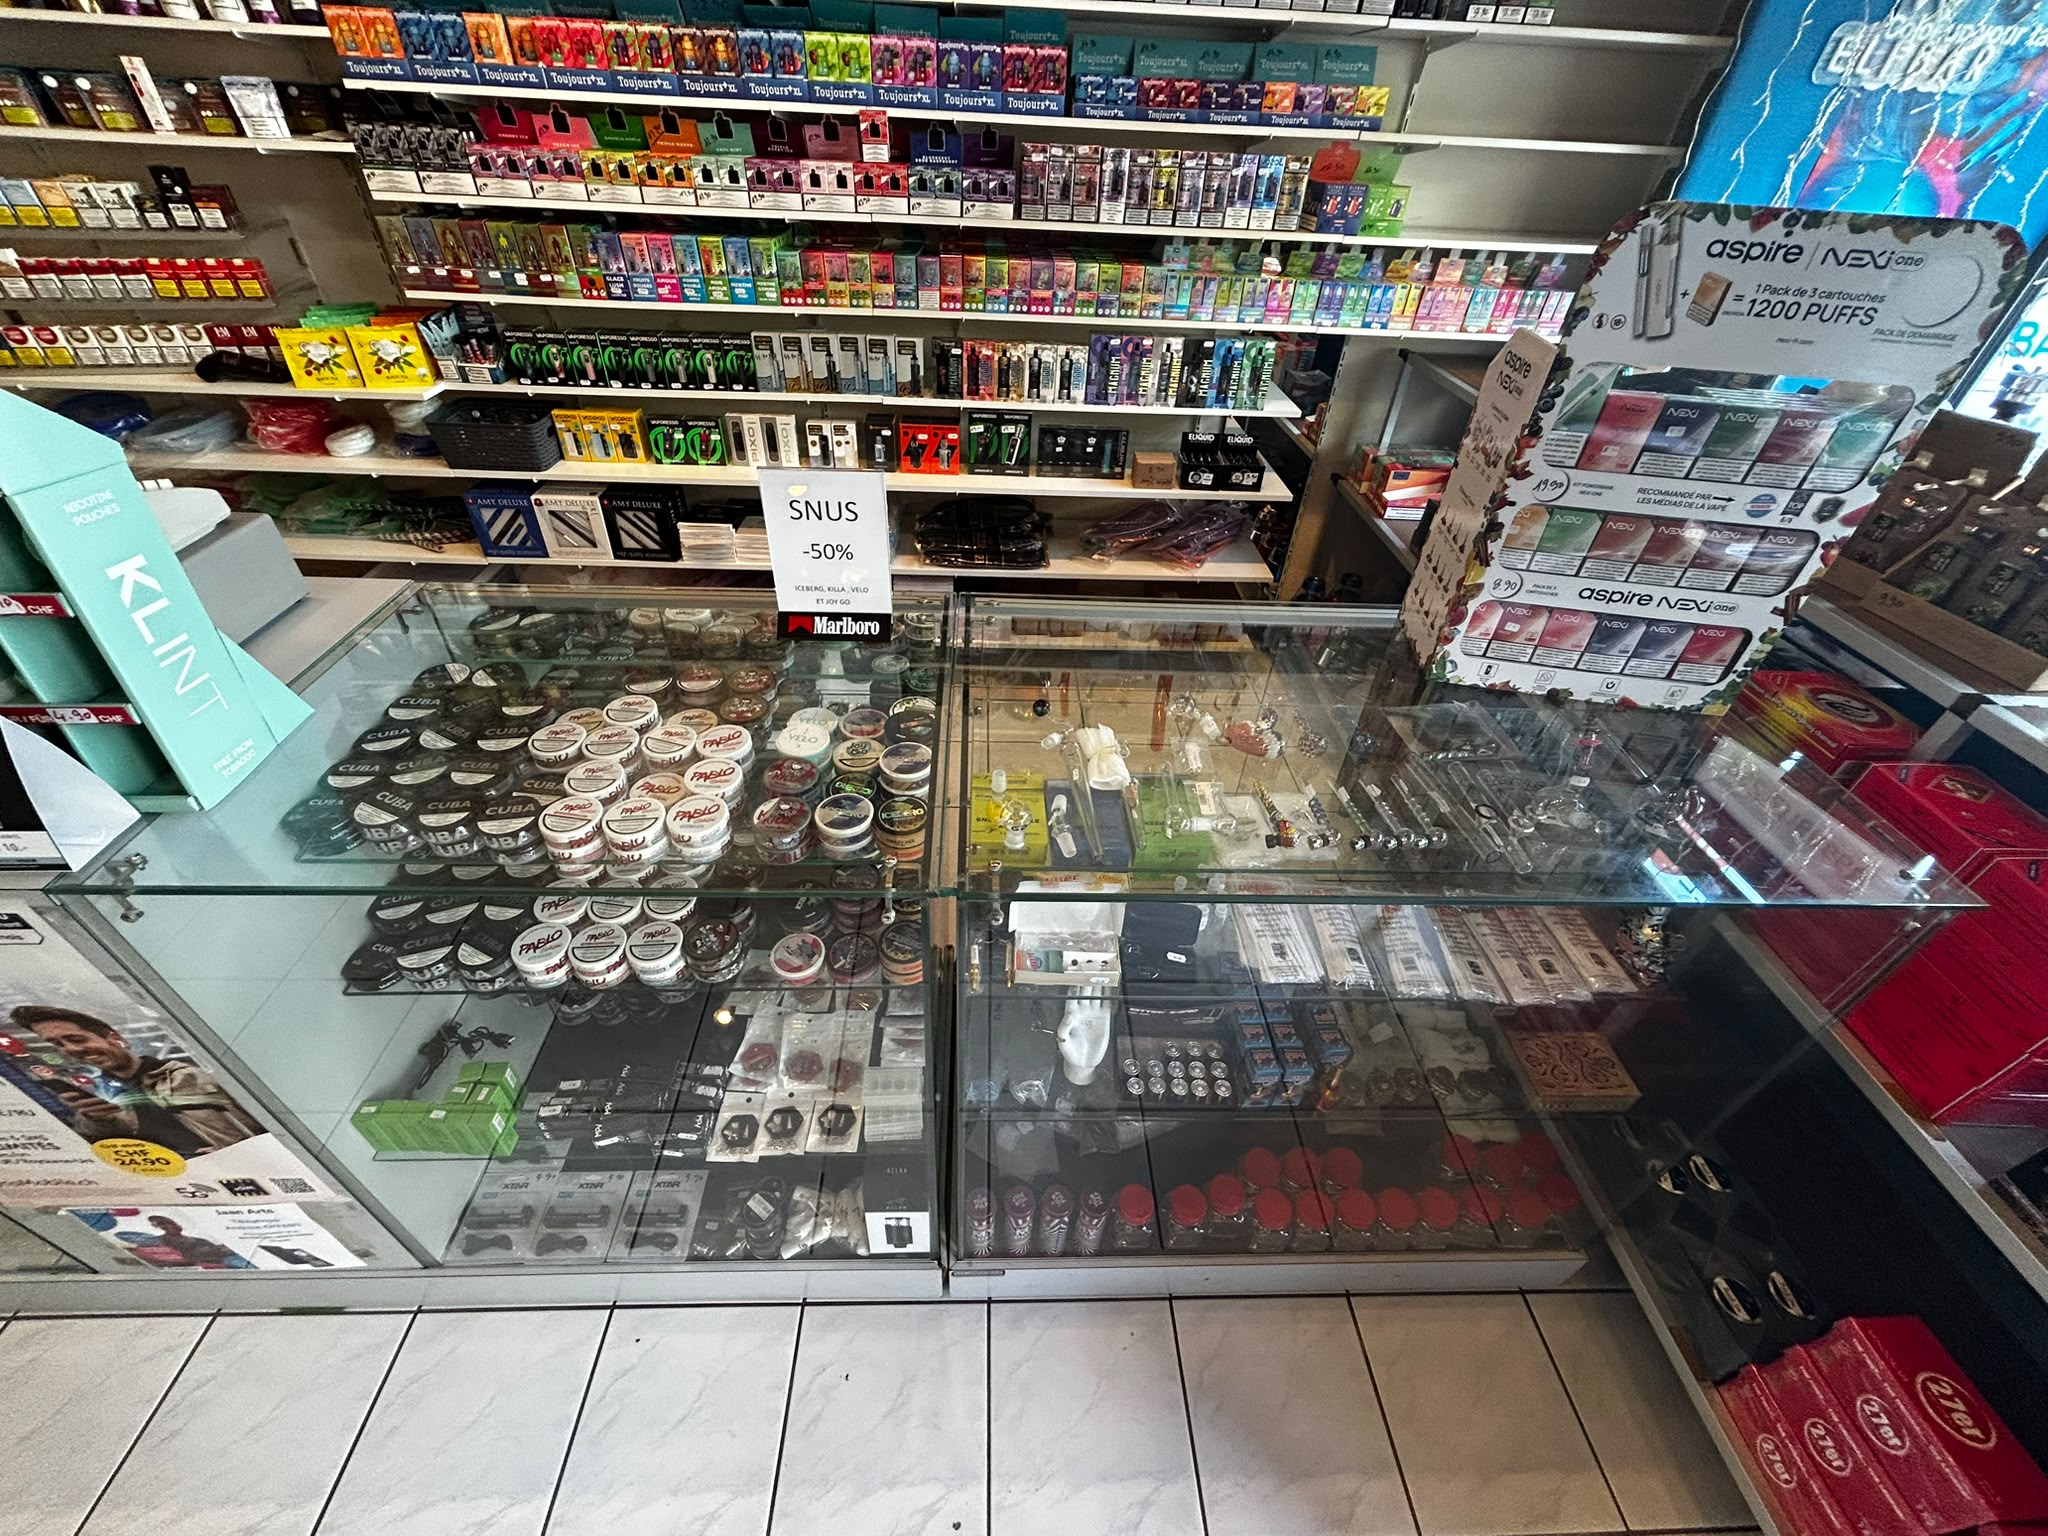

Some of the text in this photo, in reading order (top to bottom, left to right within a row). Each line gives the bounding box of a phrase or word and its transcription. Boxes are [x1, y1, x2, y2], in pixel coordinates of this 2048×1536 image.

[1706, 230, 1803, 264] aspire
[1895, 255, 1925, 269] one
[1755, 284, 1887, 303] 1 Pack de 3 cartouches
[1746, 299, 1878, 326] 1200 PUFFS
[503, 331, 533, 339] VAPORESSO
[536, 332, 565, 340] VAPORESSO
[1505, 350, 1532, 379] aspire
[1107, 356, 1121, 394] MAGNUM
[1138, 356, 1152, 394] MAGNUM
[1168, 358, 1182, 396] MAGNUM
[1199, 359, 1213, 397] MAGNUM
[1229, 360, 1242, 397] MAGNUM
[1260, 361, 1273, 399] MAGNUM
[1637, 487, 1713, 501] RECOMMANDÉ PAR
[62, 489, 115, 515] NICOTINE
[477, 498, 529, 507] AMY DELUXE
[545, 499, 596, 508] AMY DELUXE
[613, 500, 663, 509] AMY DELUXE
[1636, 497, 1650, 505] LES
[1651, 497, 1682, 507] MÉDIAS
[1707, 504, 1728, 512] VAPE
[73, 503, 120, 526] POUCHES
[789, 500, 858, 522] SNUS
[803, 543, 854, 560] -50%
[795, 585, 826, 593] ICEBERG,
[1491, 578, 1517, 591] 8.90
[1578, 587, 1653, 607] aspire
[1713, 604, 1736, 612] one
[27, 605, 55, 615] CHF
[813, 616, 880, 635] Marlboro
[105, 553, 229, 719] KLINT
[400, 697, 441, 706] CUBA
[620, 699, 648, 707] PABLO
[52, 710, 91, 722] 4.90
[98, 715, 124, 723] CHF
[568, 710, 595, 721] PABLO
[681, 711, 708, 721] PABLO
[367, 727, 411, 740] CUBA
[485, 726, 530, 736] CUBA
[546, 727, 576, 736] PABLO
[599, 730, 627, 740] PABLO
[789, 733, 818, 743] VELO
[703, 731, 742, 748] PABLO
[212, 738, 254, 772] FREE FROM
[338, 764, 380, 773] CUBA
[395, 756, 447, 770] CUBA
[460, 761, 499, 770] CUBA
[583, 765, 613, 775] PABLO
[690, 767, 735, 782] PABLO
[637, 781, 680, 795] PABLO
[376, 791, 413, 811] CUBA
[427, 800, 471, 810] CUBA
[560, 802, 593, 812] PABLO
[485, 803, 536, 816] CUBA
[620, 803, 651, 815] PABLO
[673, 804, 721, 822] PABLO
[586, 929, 615, 942] PABLO
[642, 926, 672, 941] PABLO
[519, 930, 563, 956] PABLO
[114, 1150, 150, 1158] CHF
[114, 1158, 171, 1166] 24.90
[1927, 1380, 1983, 1440] 27er
[1861, 1400, 1902, 1448] 27er
[1809, 1424, 1846, 1469] 27er
[1760, 1440, 1792, 1485] 27er
